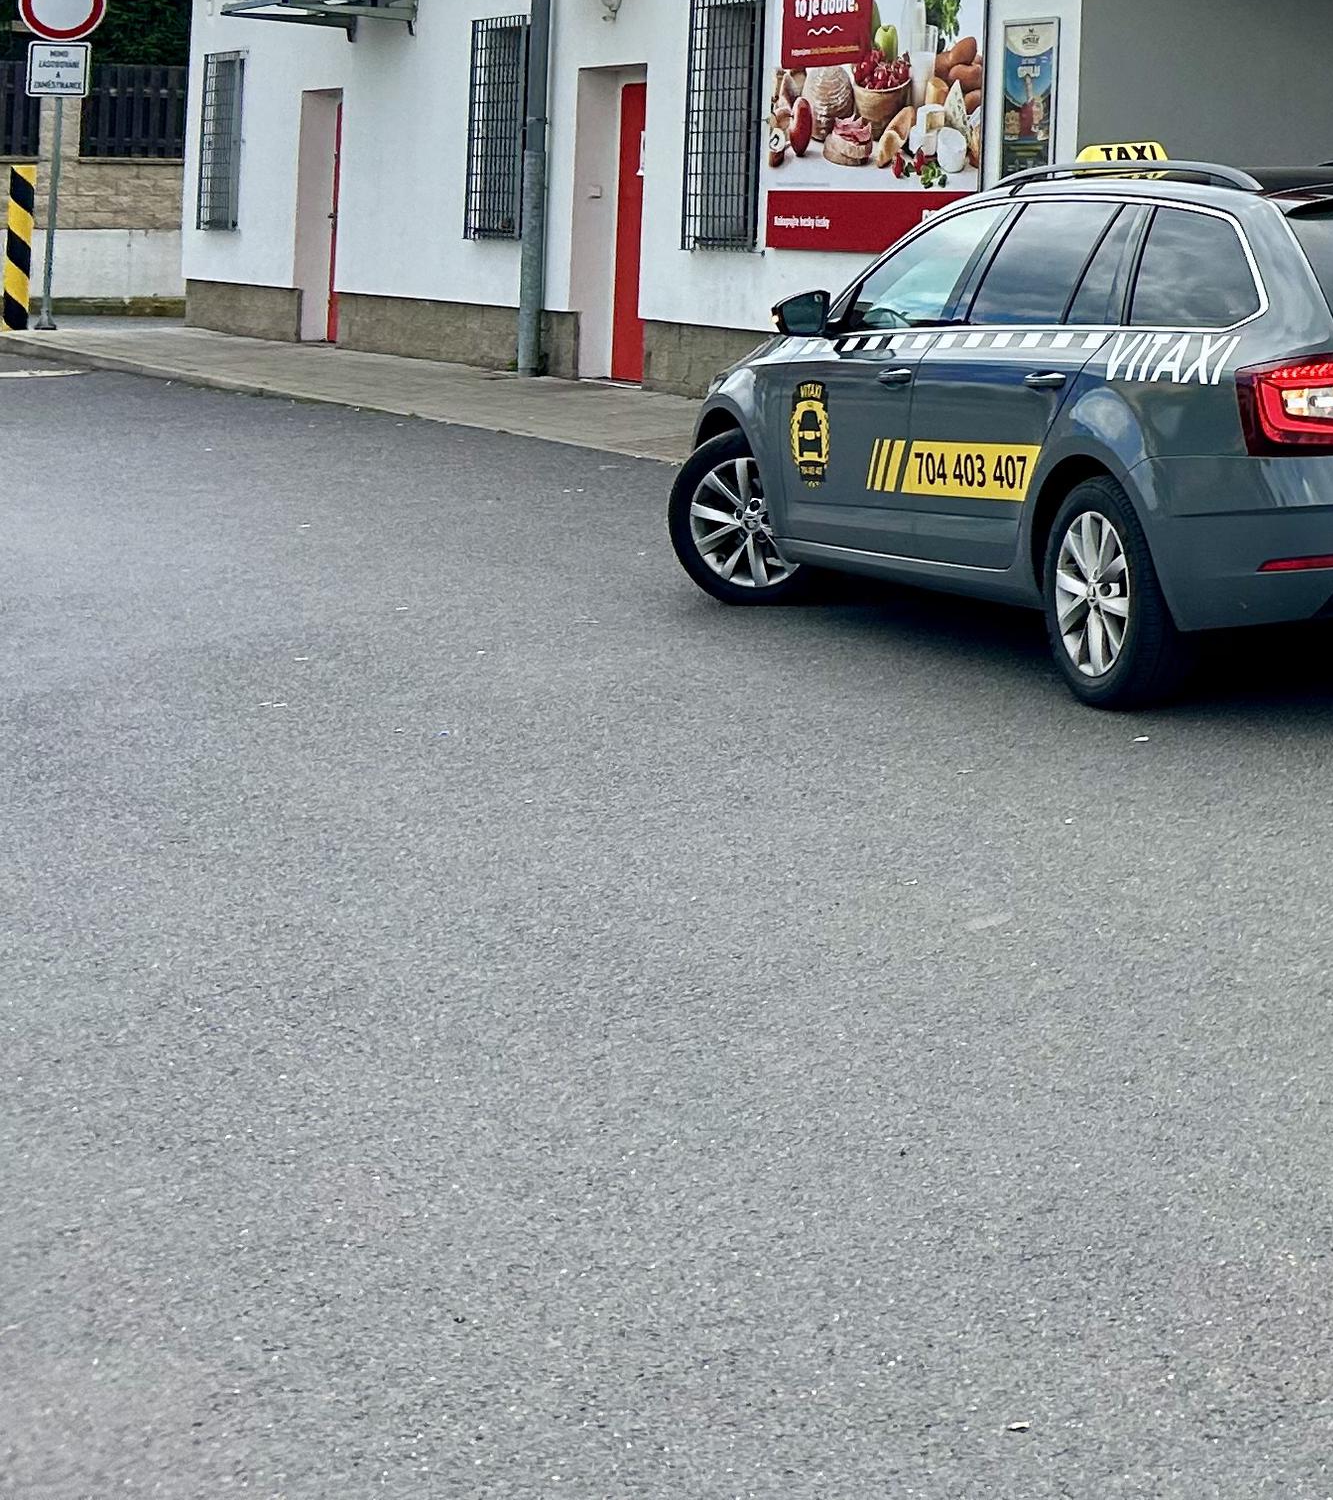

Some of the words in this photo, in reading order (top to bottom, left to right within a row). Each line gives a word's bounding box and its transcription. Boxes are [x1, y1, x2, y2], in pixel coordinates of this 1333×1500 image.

[1100, 144, 1158, 161] TAXI
[1106, 333, 1242, 385] VITAXI
[800, 383, 822, 399] VITAXI
[914, 452, 947, 486] 704
[953, 453, 986, 488] 403
[993, 454, 1027, 490] 407
